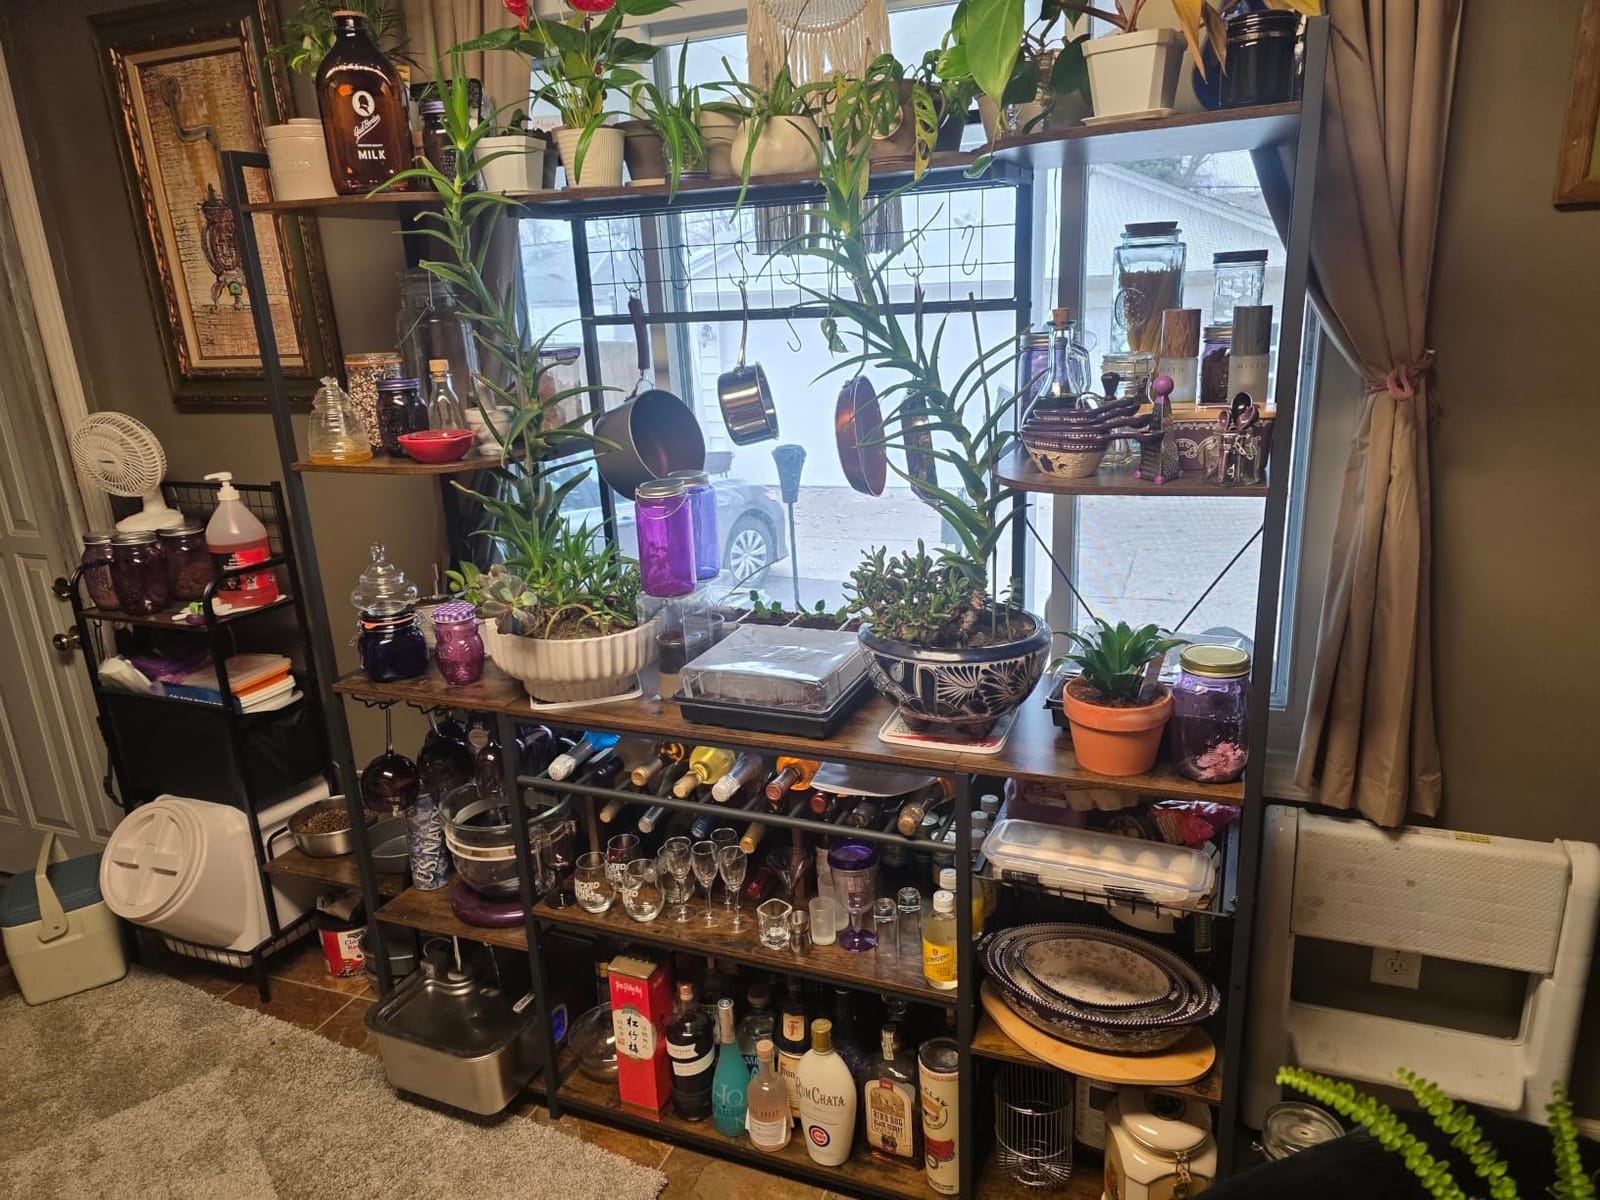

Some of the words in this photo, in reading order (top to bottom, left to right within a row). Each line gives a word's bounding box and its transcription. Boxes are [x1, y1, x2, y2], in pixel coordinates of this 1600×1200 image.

[357, 150, 386, 160] MILK
[422, 806, 441, 856] NAVY
[891, 1114, 904, 1127] DOG
